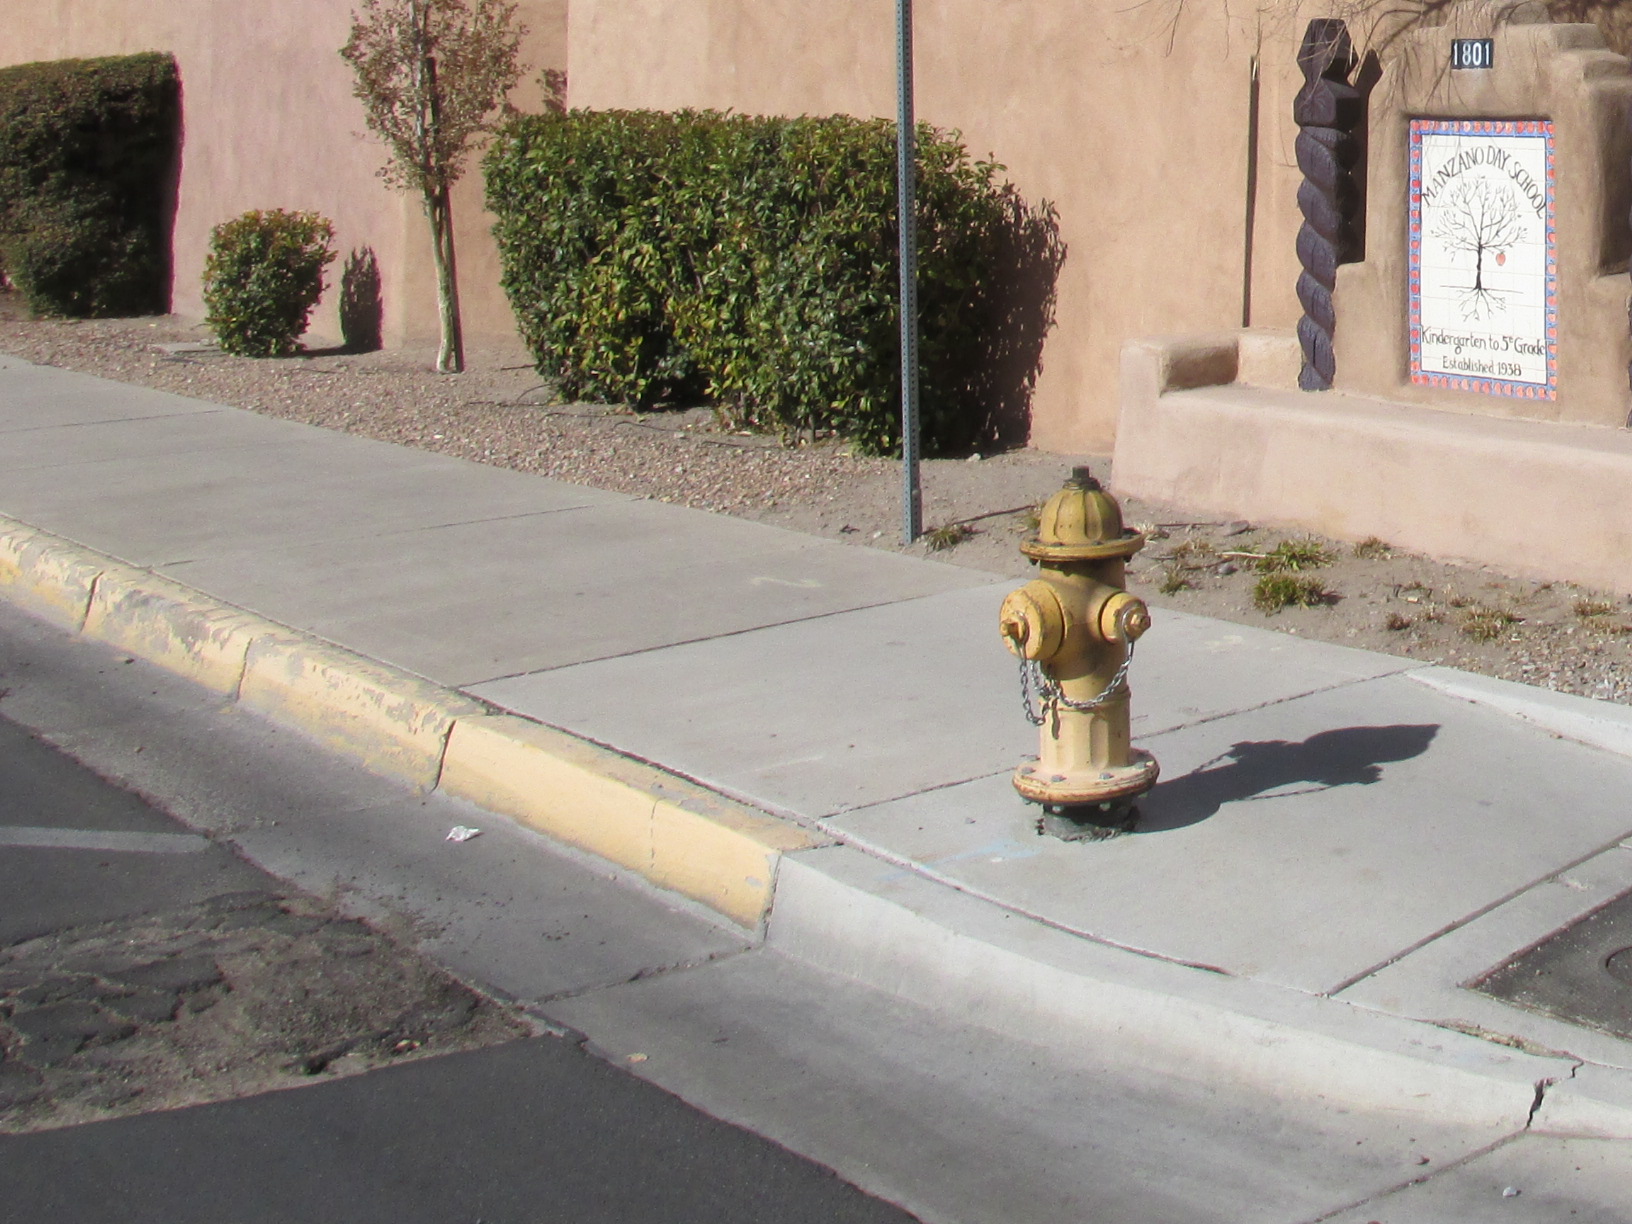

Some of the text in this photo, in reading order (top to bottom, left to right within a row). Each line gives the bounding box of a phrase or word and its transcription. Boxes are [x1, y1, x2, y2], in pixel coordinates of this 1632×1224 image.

[1453, 42, 1490, 66] 1801
[1421, 145, 1547, 220] MANZANO DAY SCHOOL
[1421, 325, 1487, 355] Kindergarten
[1488, 334, 1500, 351] to
[1514, 336, 1545, 357] Grade
[1442, 356, 1522, 377] Established 1938
